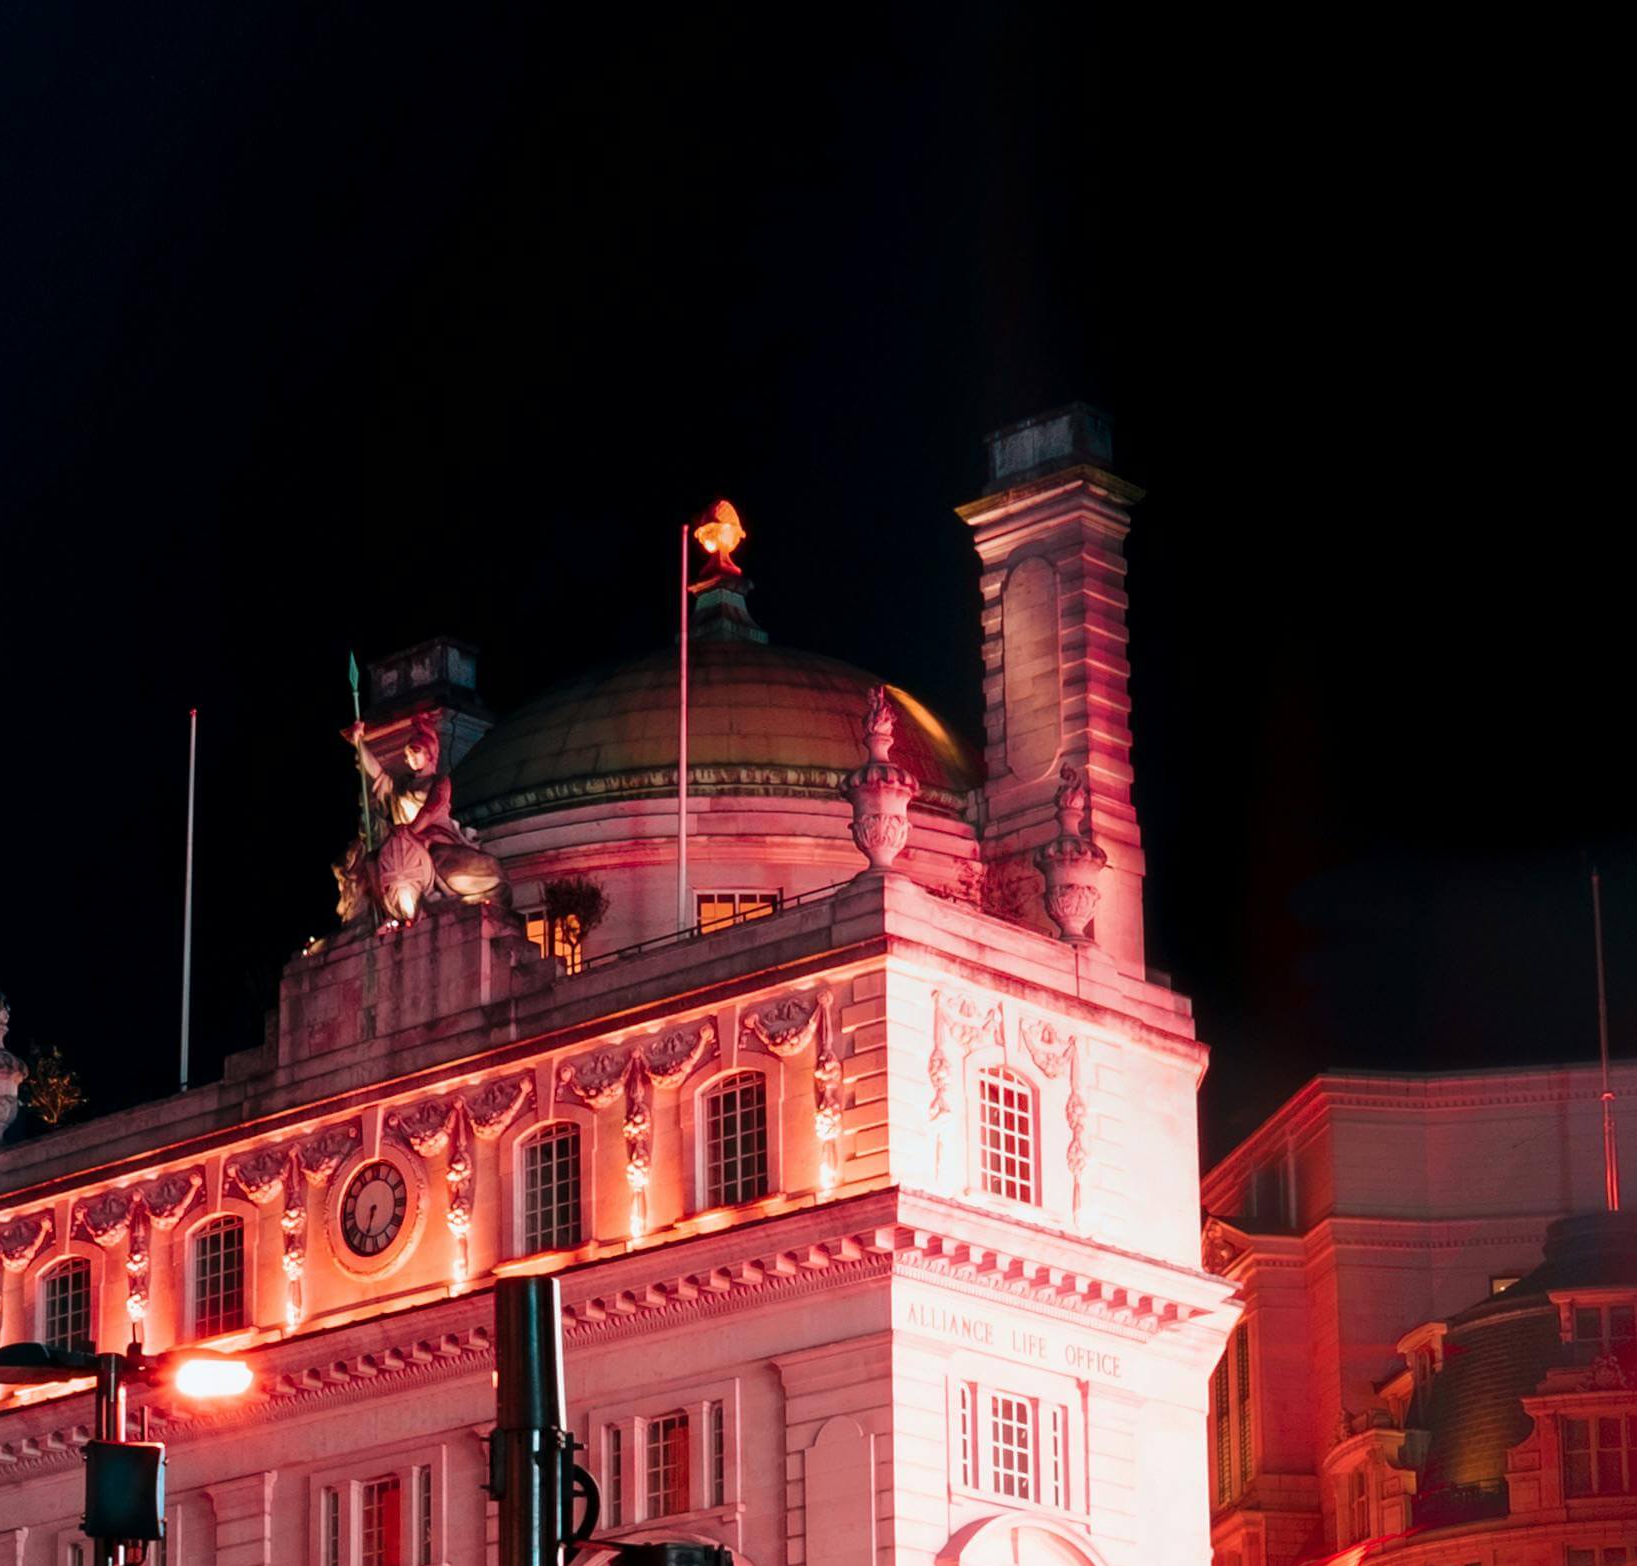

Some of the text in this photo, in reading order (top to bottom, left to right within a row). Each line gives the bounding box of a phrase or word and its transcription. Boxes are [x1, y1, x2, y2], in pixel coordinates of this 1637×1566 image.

[908, 1302, 1122, 1378] ALLIANCE LIFE OFFICE
